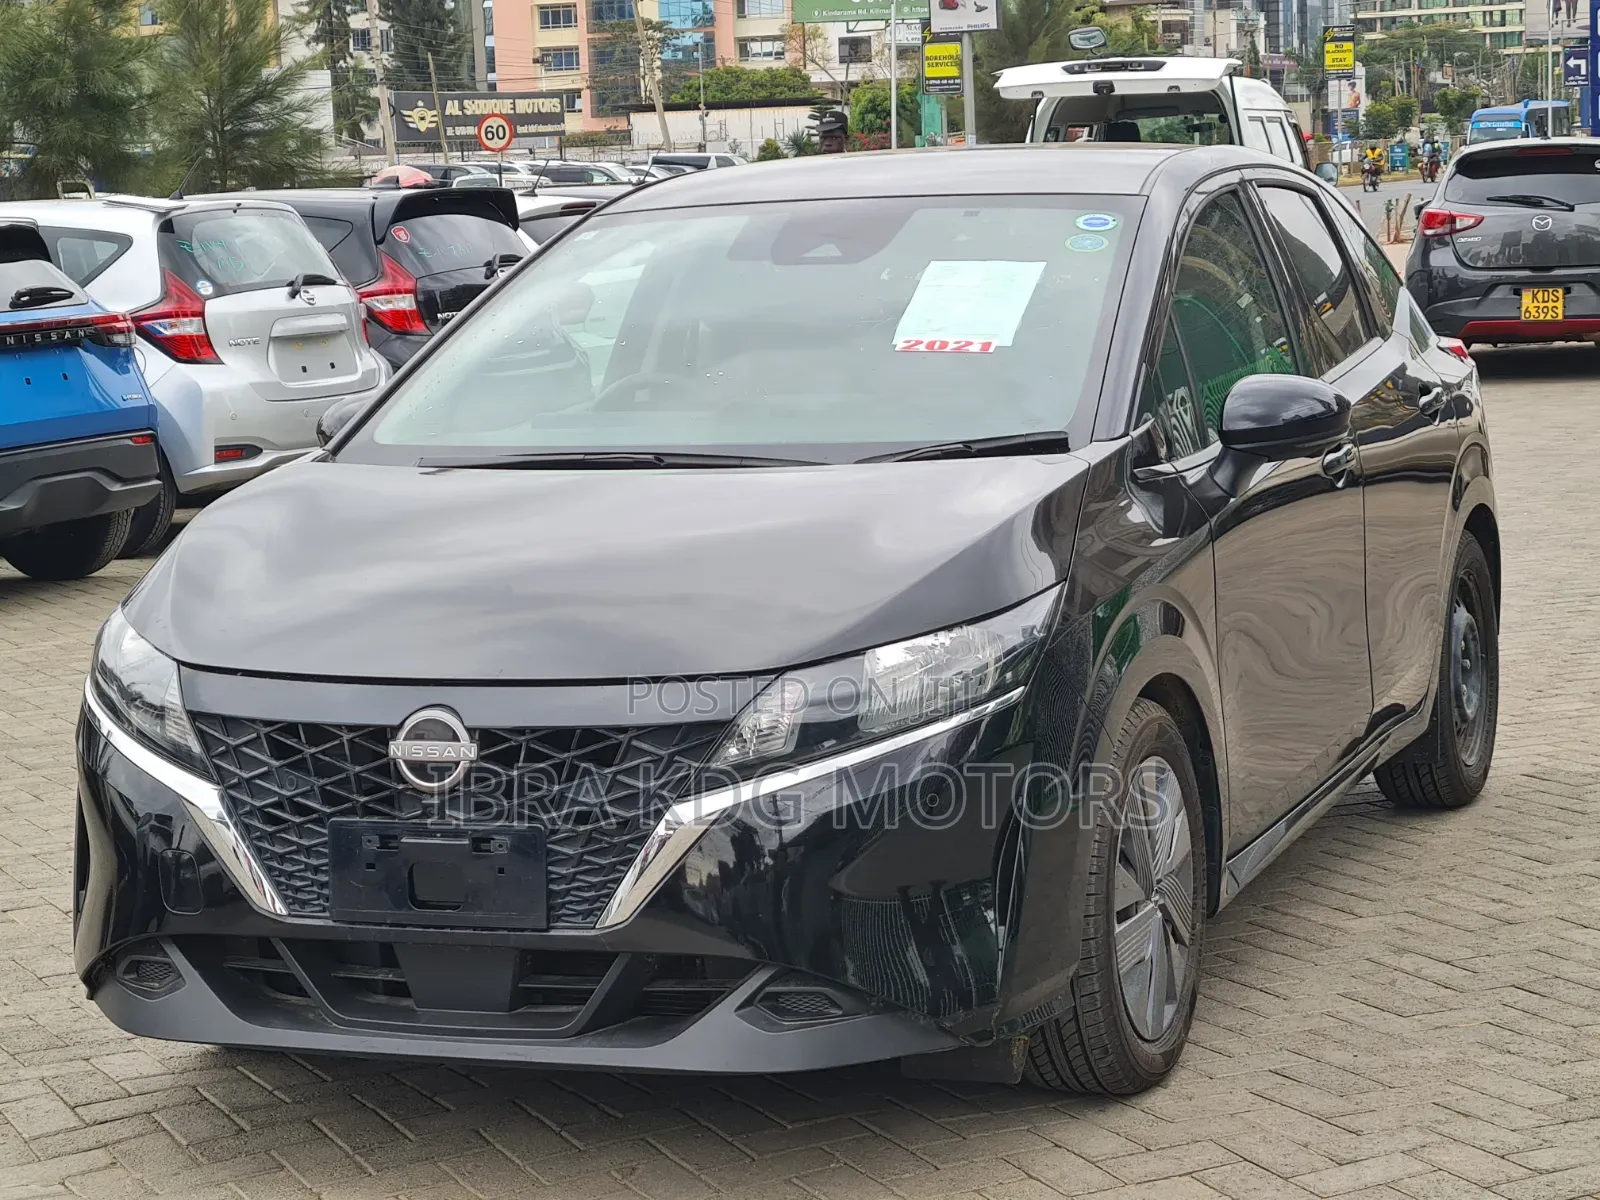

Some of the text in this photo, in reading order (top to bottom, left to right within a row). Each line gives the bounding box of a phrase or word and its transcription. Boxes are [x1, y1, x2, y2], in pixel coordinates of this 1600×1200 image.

[444, 99, 463, 116] AL
[514, 97, 561, 115] MOTORS
[484, 124, 507, 141] 60
[1531, 289, 1560, 304] KDS
[436, 311, 460, 320] NOT
[1523, 305, 1560, 319] 639S
[5, 328, 86, 346] NISSAN
[228, 337, 261, 348] NOTE
[901, 339, 993, 352] 2021
[389, 743, 478, 760] NISSAN
